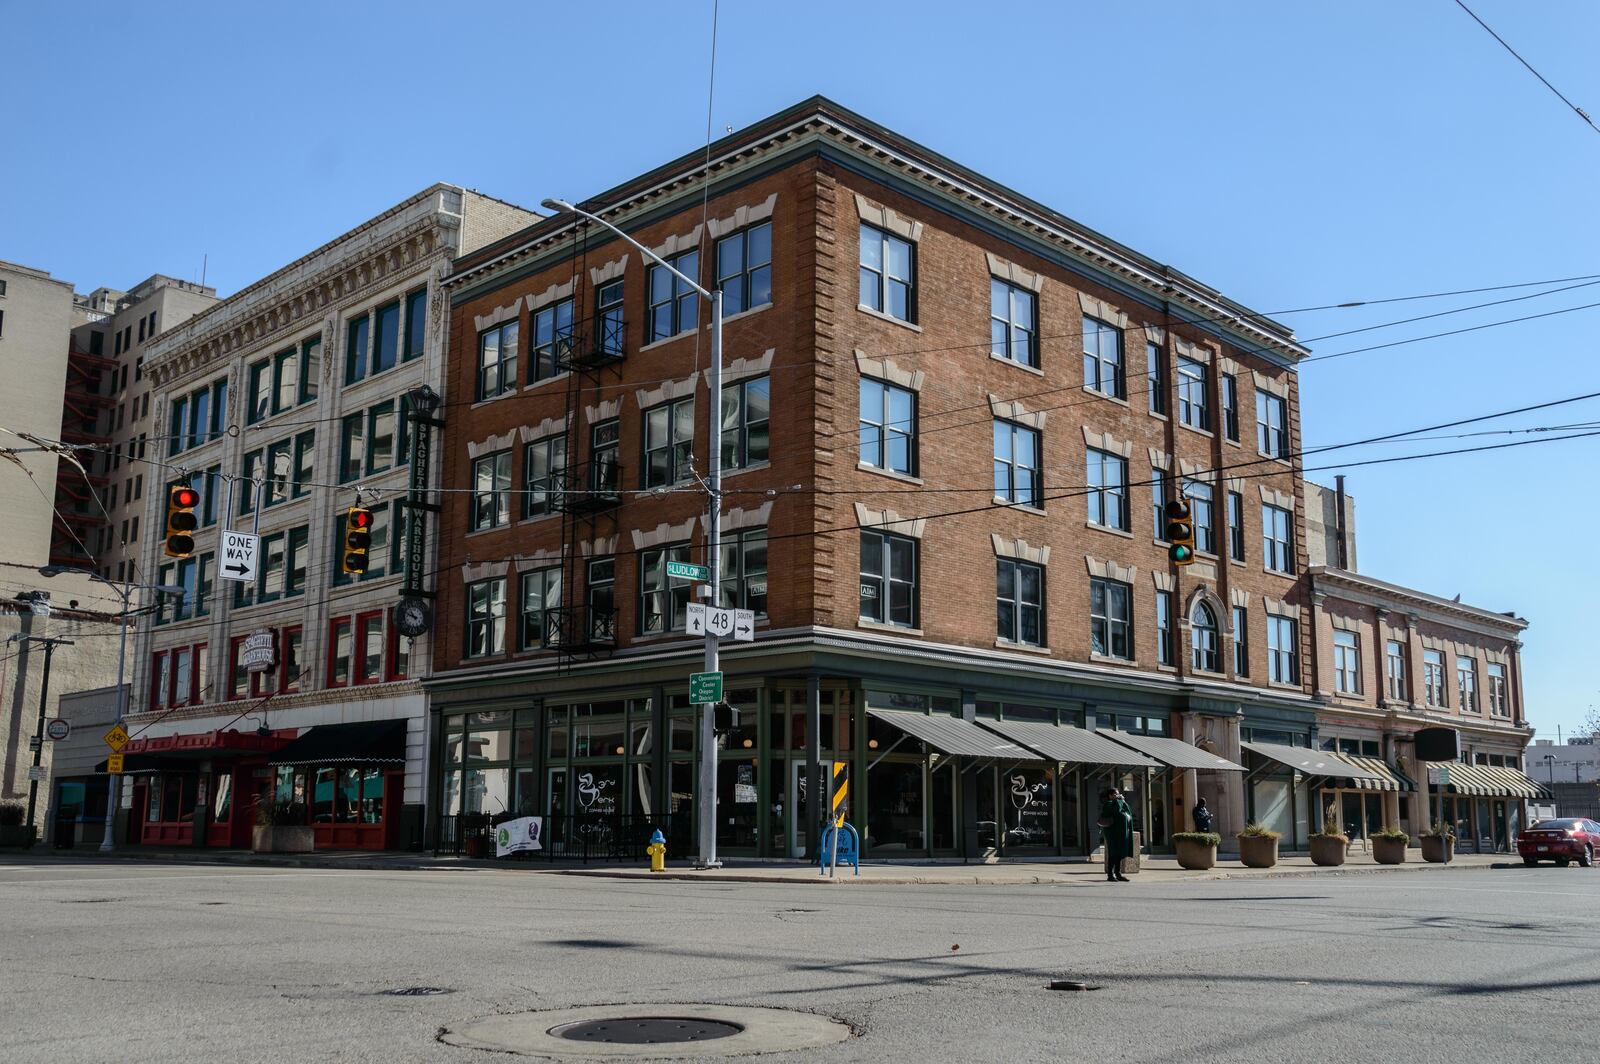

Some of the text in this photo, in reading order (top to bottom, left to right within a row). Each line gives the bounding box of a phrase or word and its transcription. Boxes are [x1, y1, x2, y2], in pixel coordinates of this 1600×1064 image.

[415, 423, 427, 502] SPAGHETTI
[228, 536, 253, 549] ONE
[411, 508, 425, 590] WAREHOUSE
[227, 547, 253, 561] WAY
[672, 564, 701, 577] LUDLOW
[688, 606, 705, 614] NORTH
[737, 612, 753, 621] SOUTH
[712, 612, 728, 630] 48
